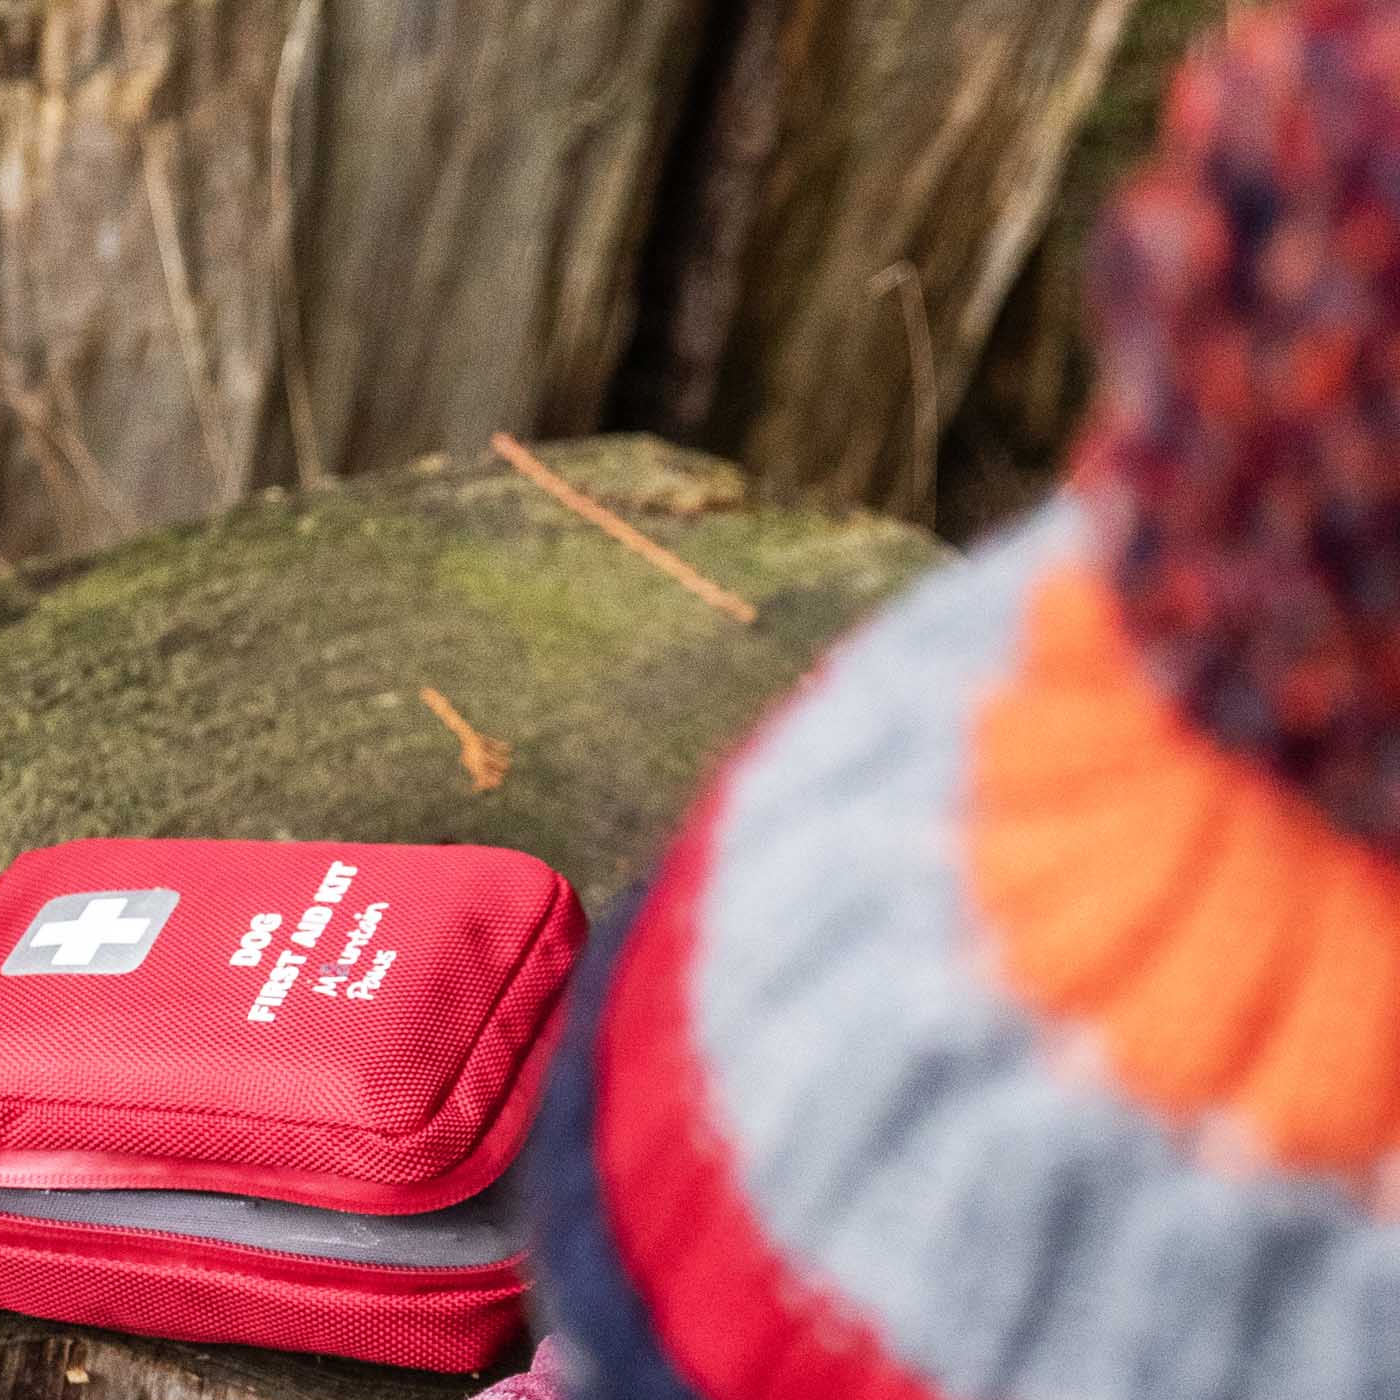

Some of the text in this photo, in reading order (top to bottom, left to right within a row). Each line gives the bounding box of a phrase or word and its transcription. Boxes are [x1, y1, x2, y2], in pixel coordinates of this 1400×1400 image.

[229, 913, 283, 967] DOG
[247, 860, 358, 1022] FIRST AID KIT
[311, 902, 390, 997] Muntain
[346, 950, 397, 1000] Paws
